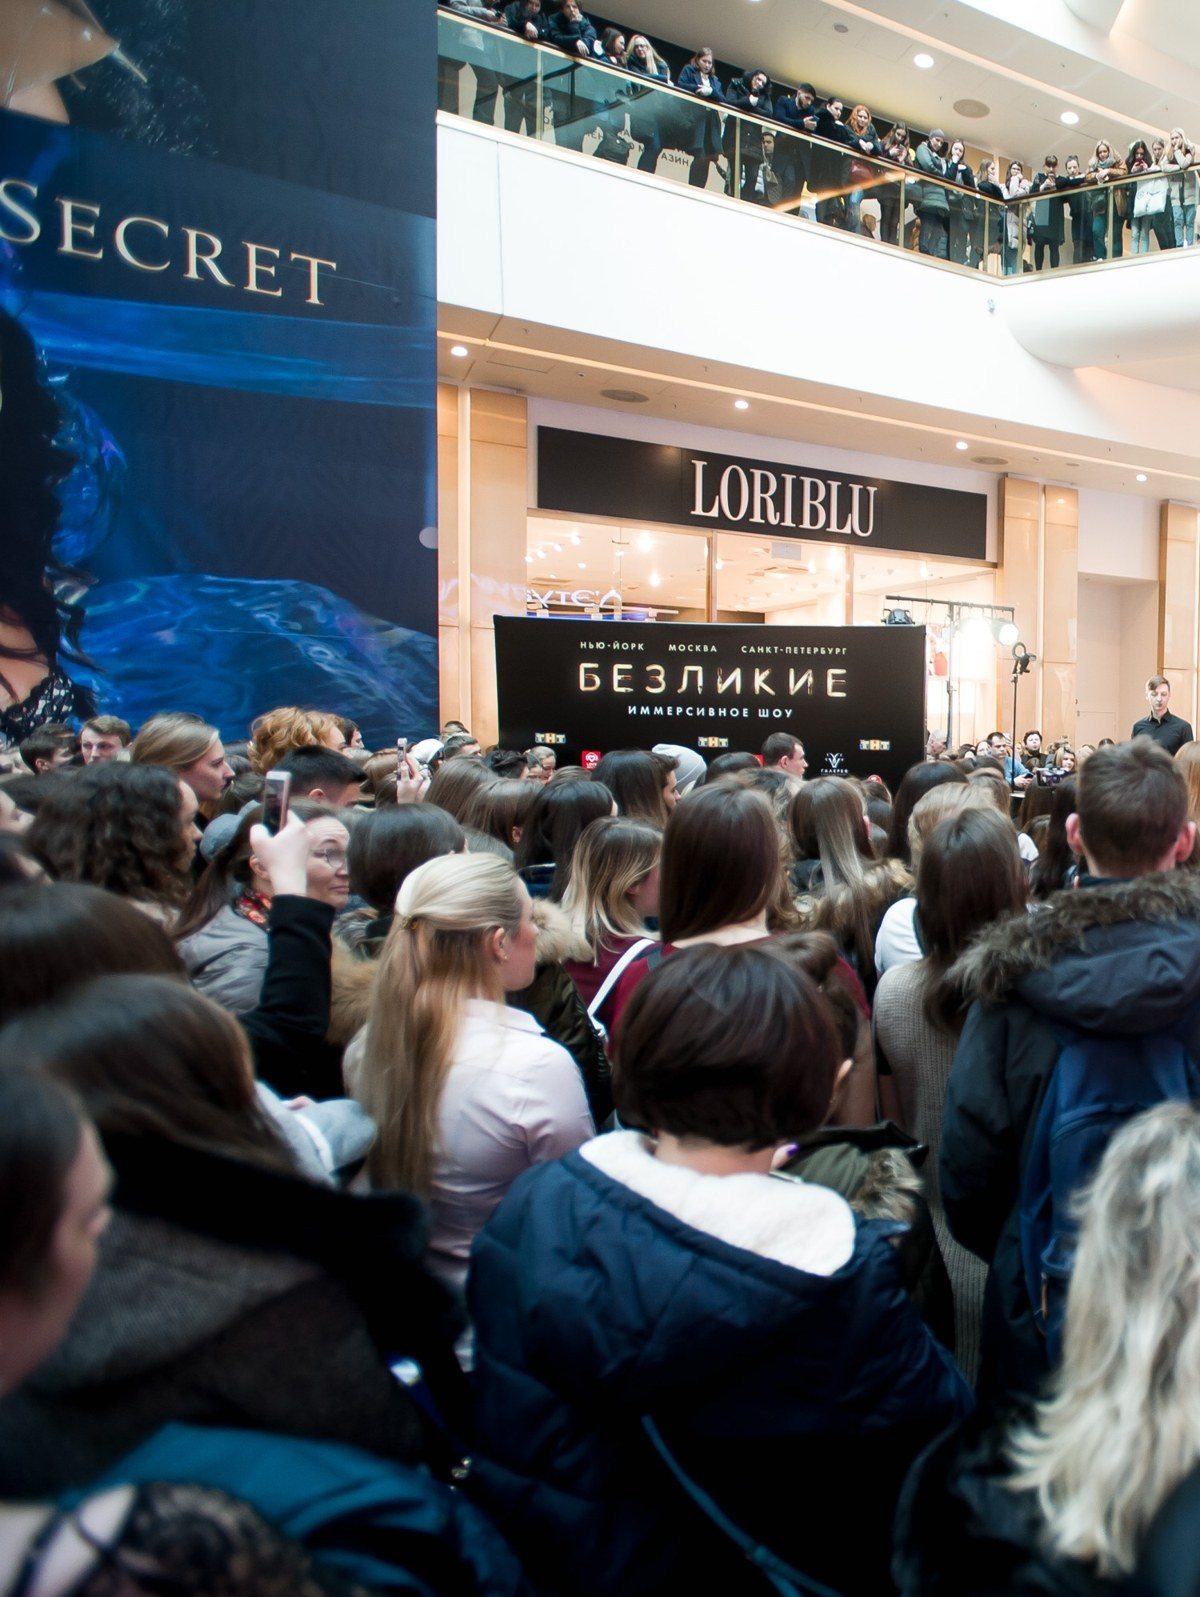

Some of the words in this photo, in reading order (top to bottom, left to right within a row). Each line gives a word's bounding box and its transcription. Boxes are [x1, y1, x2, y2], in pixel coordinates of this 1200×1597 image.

[0, 178, 337, 306] SECRET
[690, 459, 878, 537] LORIBLU
[580, 640, 645, 651] НЬЮ-ЙОРК
[668, 643, 718, 653] МОСКВА
[741, 645, 847, 655] САНКТ-ПЕТЕРБУРГ
[579, 662, 848, 698] БЕЗЛИКИЕ
[628, 705, 749, 718] ИММЕРСИВНОЕ
[758, 708, 793, 719] ШОУ
[535, 732, 566, 744] ТНТ
[698, 736, 729, 748] ТНТ
[859, 739, 890, 750] ТНТ
